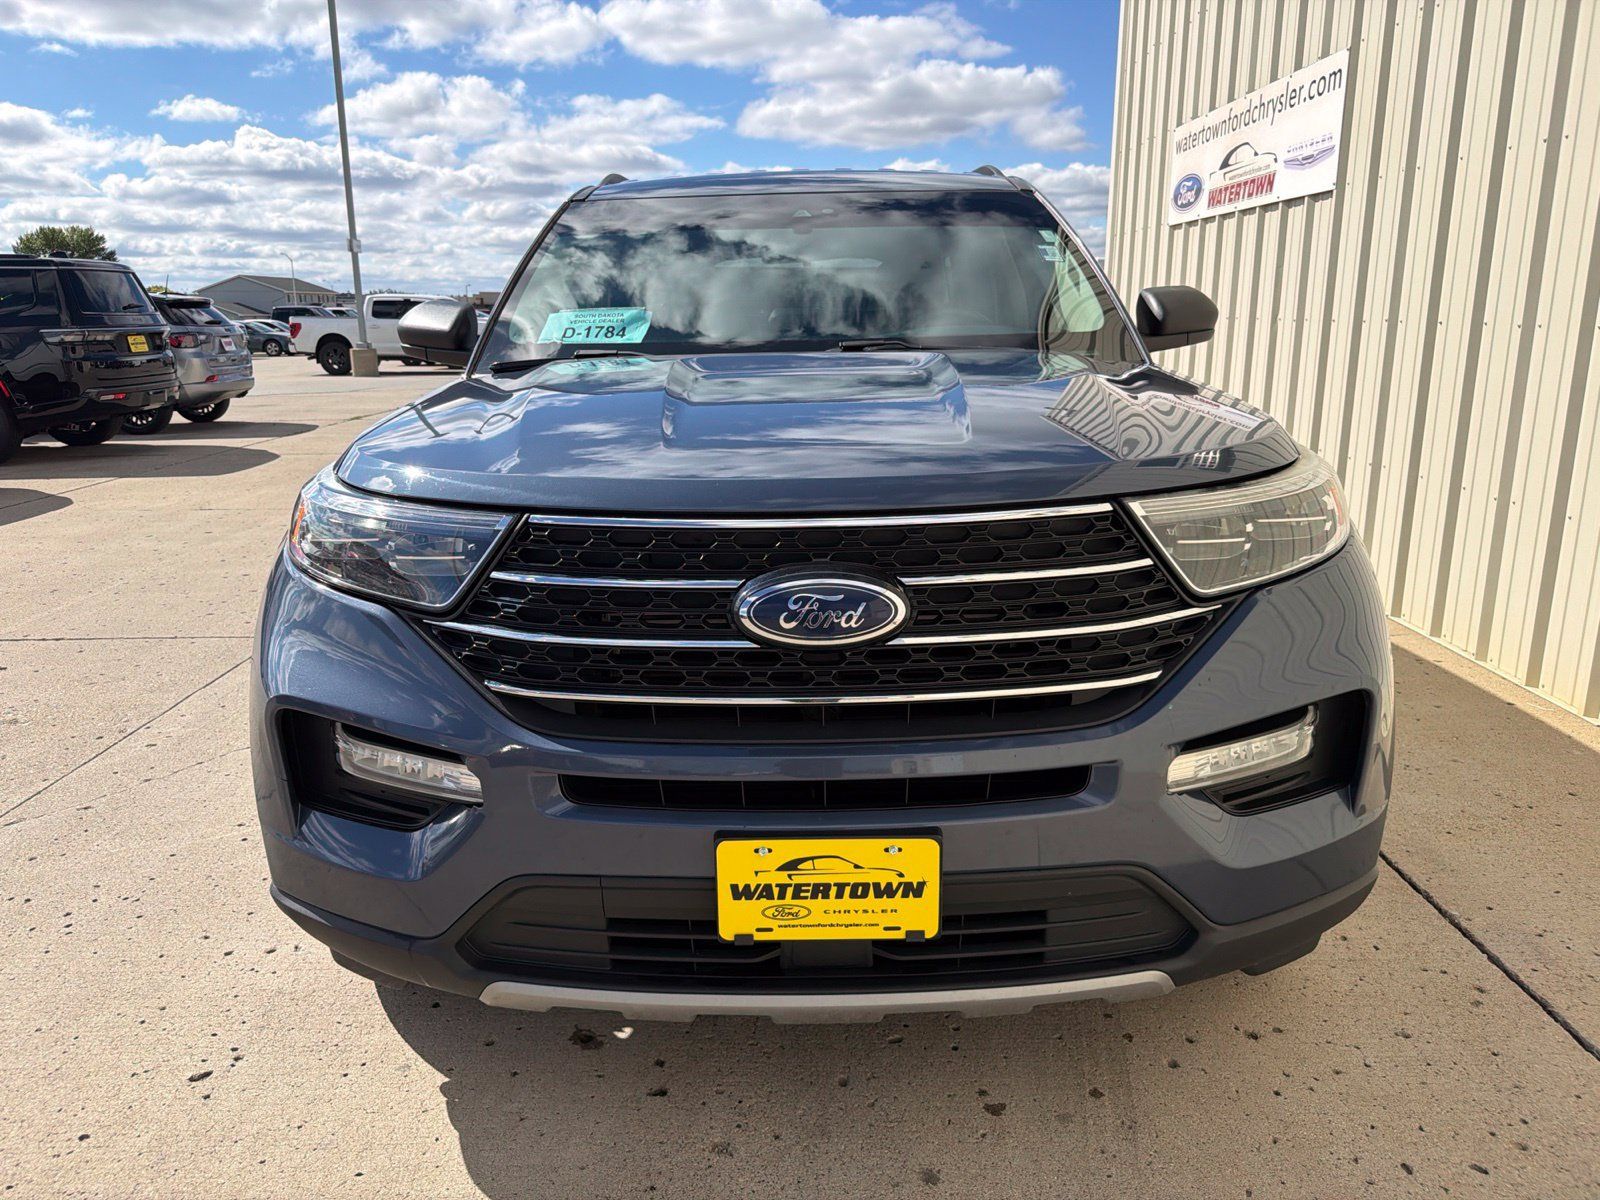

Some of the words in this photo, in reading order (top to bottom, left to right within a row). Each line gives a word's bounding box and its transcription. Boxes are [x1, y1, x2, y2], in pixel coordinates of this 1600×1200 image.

[1175, 68, 1343, 155] watertownfordchrysler.com
[1177, 180, 1198, 207] Ford
[1207, 171, 1277, 209] WATERTOWN
[562, 325, 627, 339] D-1784
[779, 593, 867, 630] Ford
[729, 881, 926, 901] WATERTOWN
[771, 906, 801, 918] Ford
